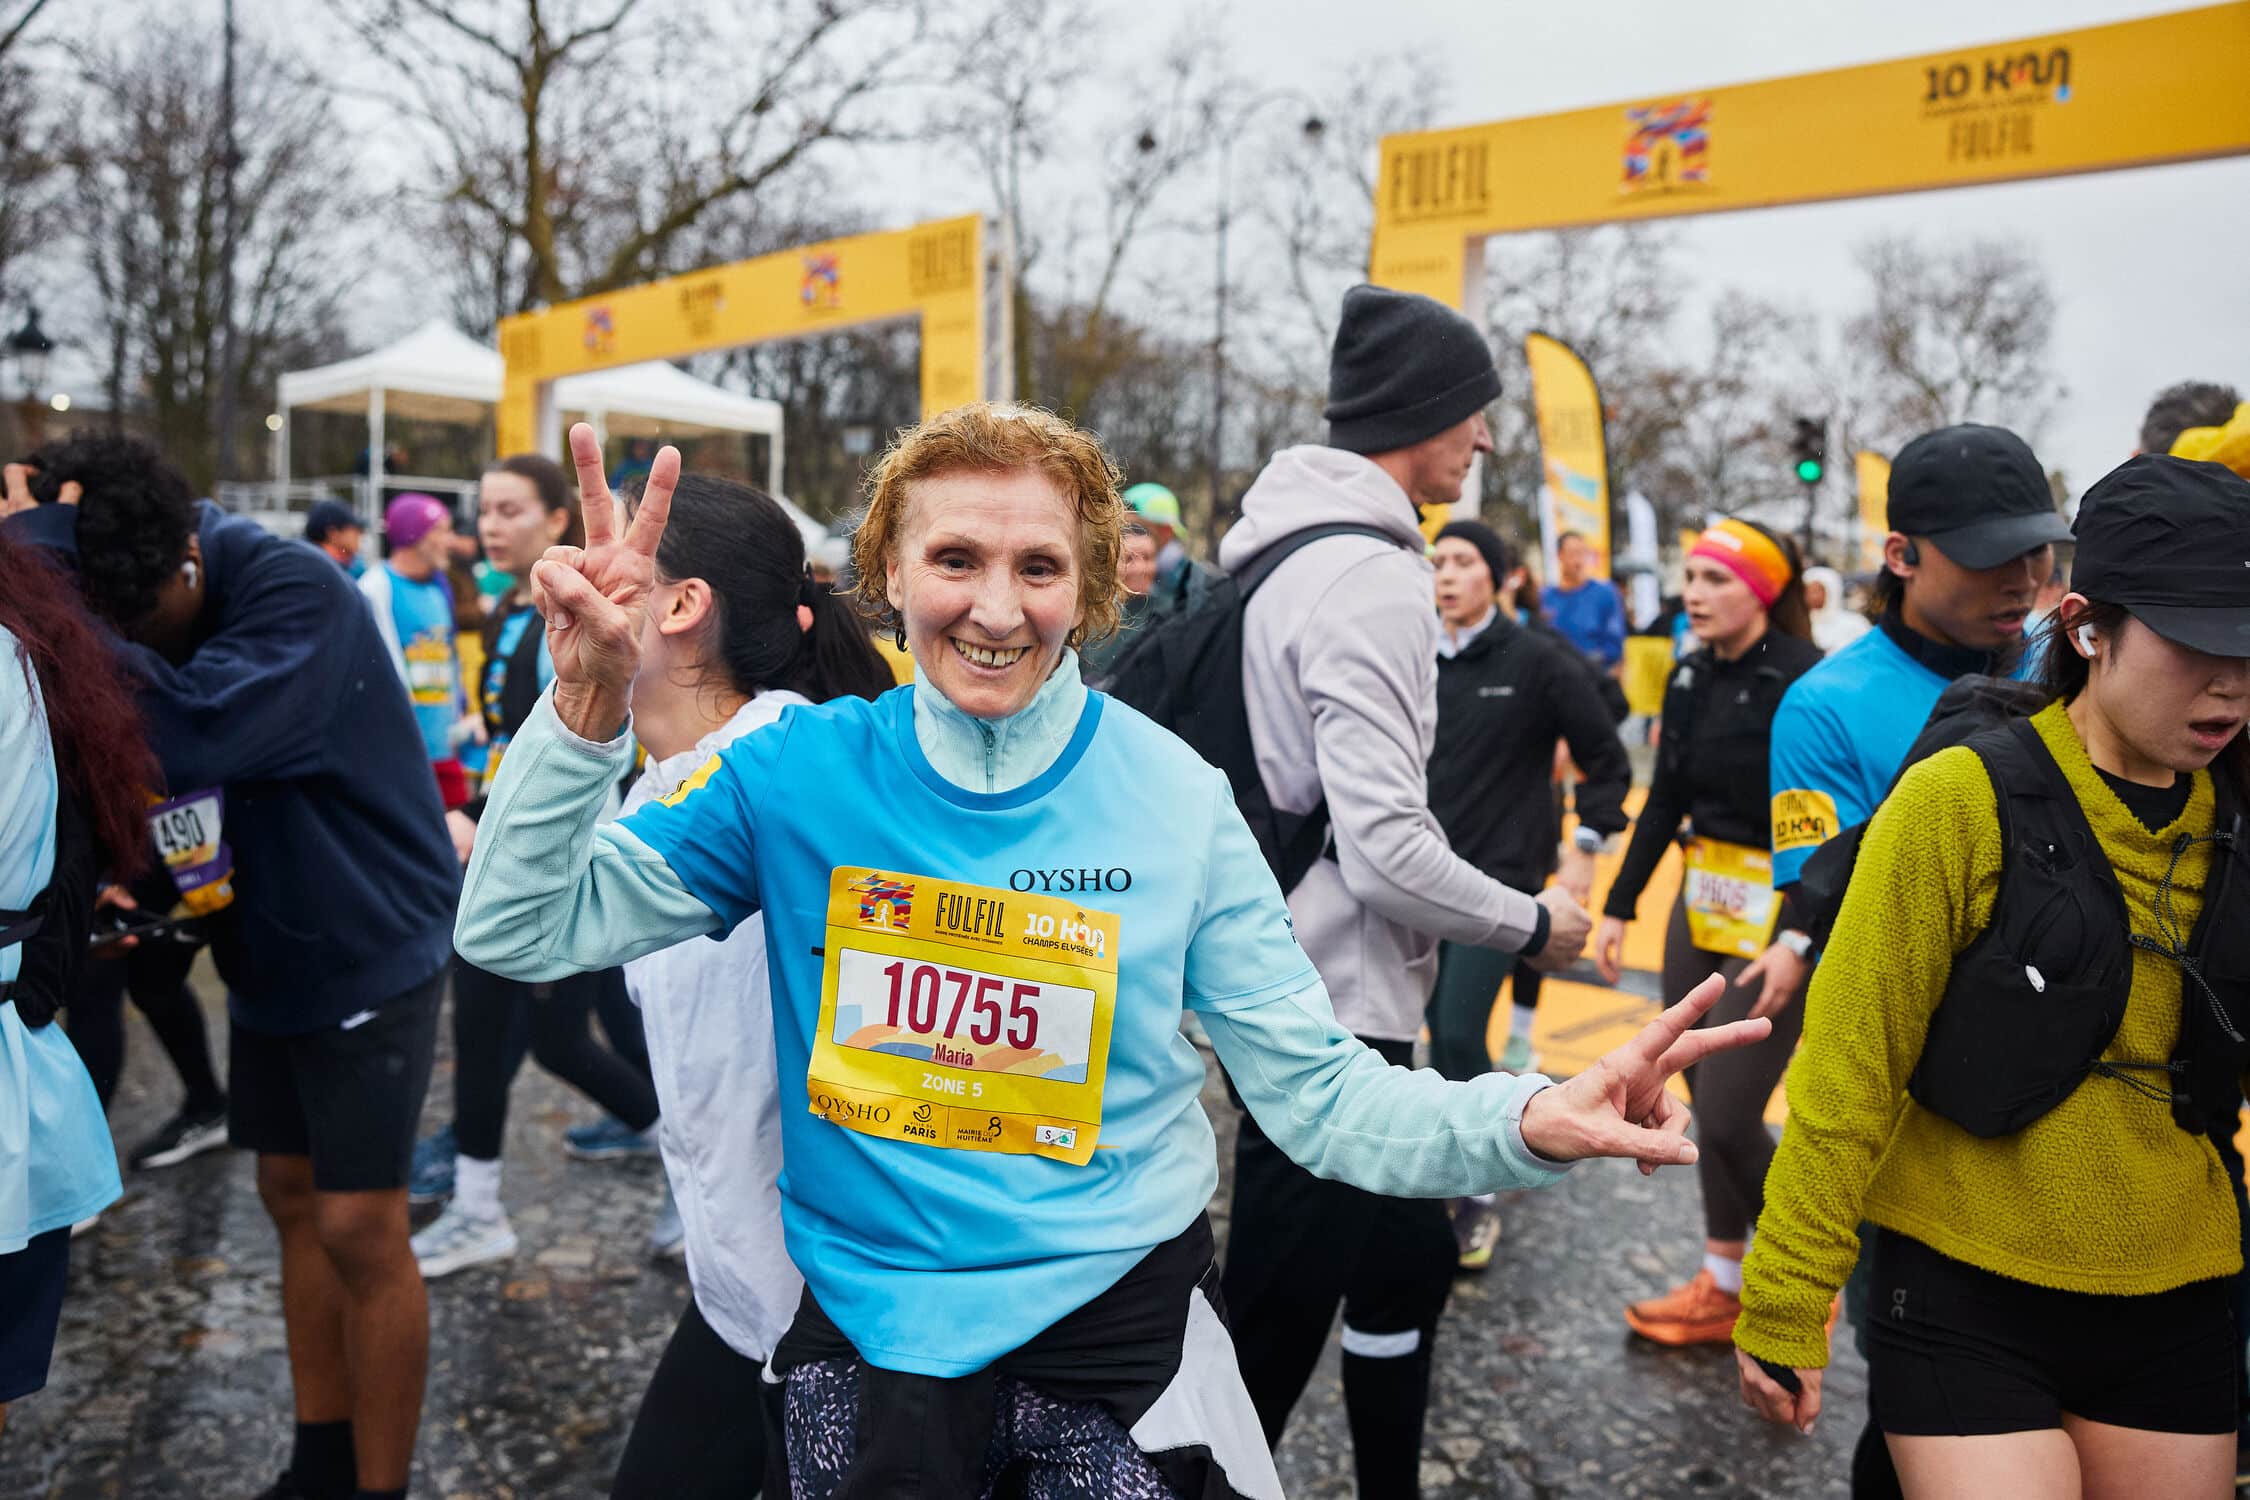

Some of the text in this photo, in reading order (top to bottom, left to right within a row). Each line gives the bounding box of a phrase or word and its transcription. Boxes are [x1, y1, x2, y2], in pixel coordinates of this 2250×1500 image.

[1926, 64, 1970, 101] 10
[1390, 141, 1491, 210] FULFIL
[1009, 867, 1133, 893] OYSHO
[935, 892, 1005, 938] FULFIL
[1024, 912, 1055, 938] 10
[1022, 936, 1060, 950] CHAMPS
[884, 961, 1041, 1050] 10755
[935, 1043, 974, 1067] Maria
[922, 1073, 983, 1098] ZONE 5
[817, 1094, 891, 1123] OYSHO
[903, 1125, 937, 1139] PARIS
[957, 1128, 981, 1136] MAIRIE
